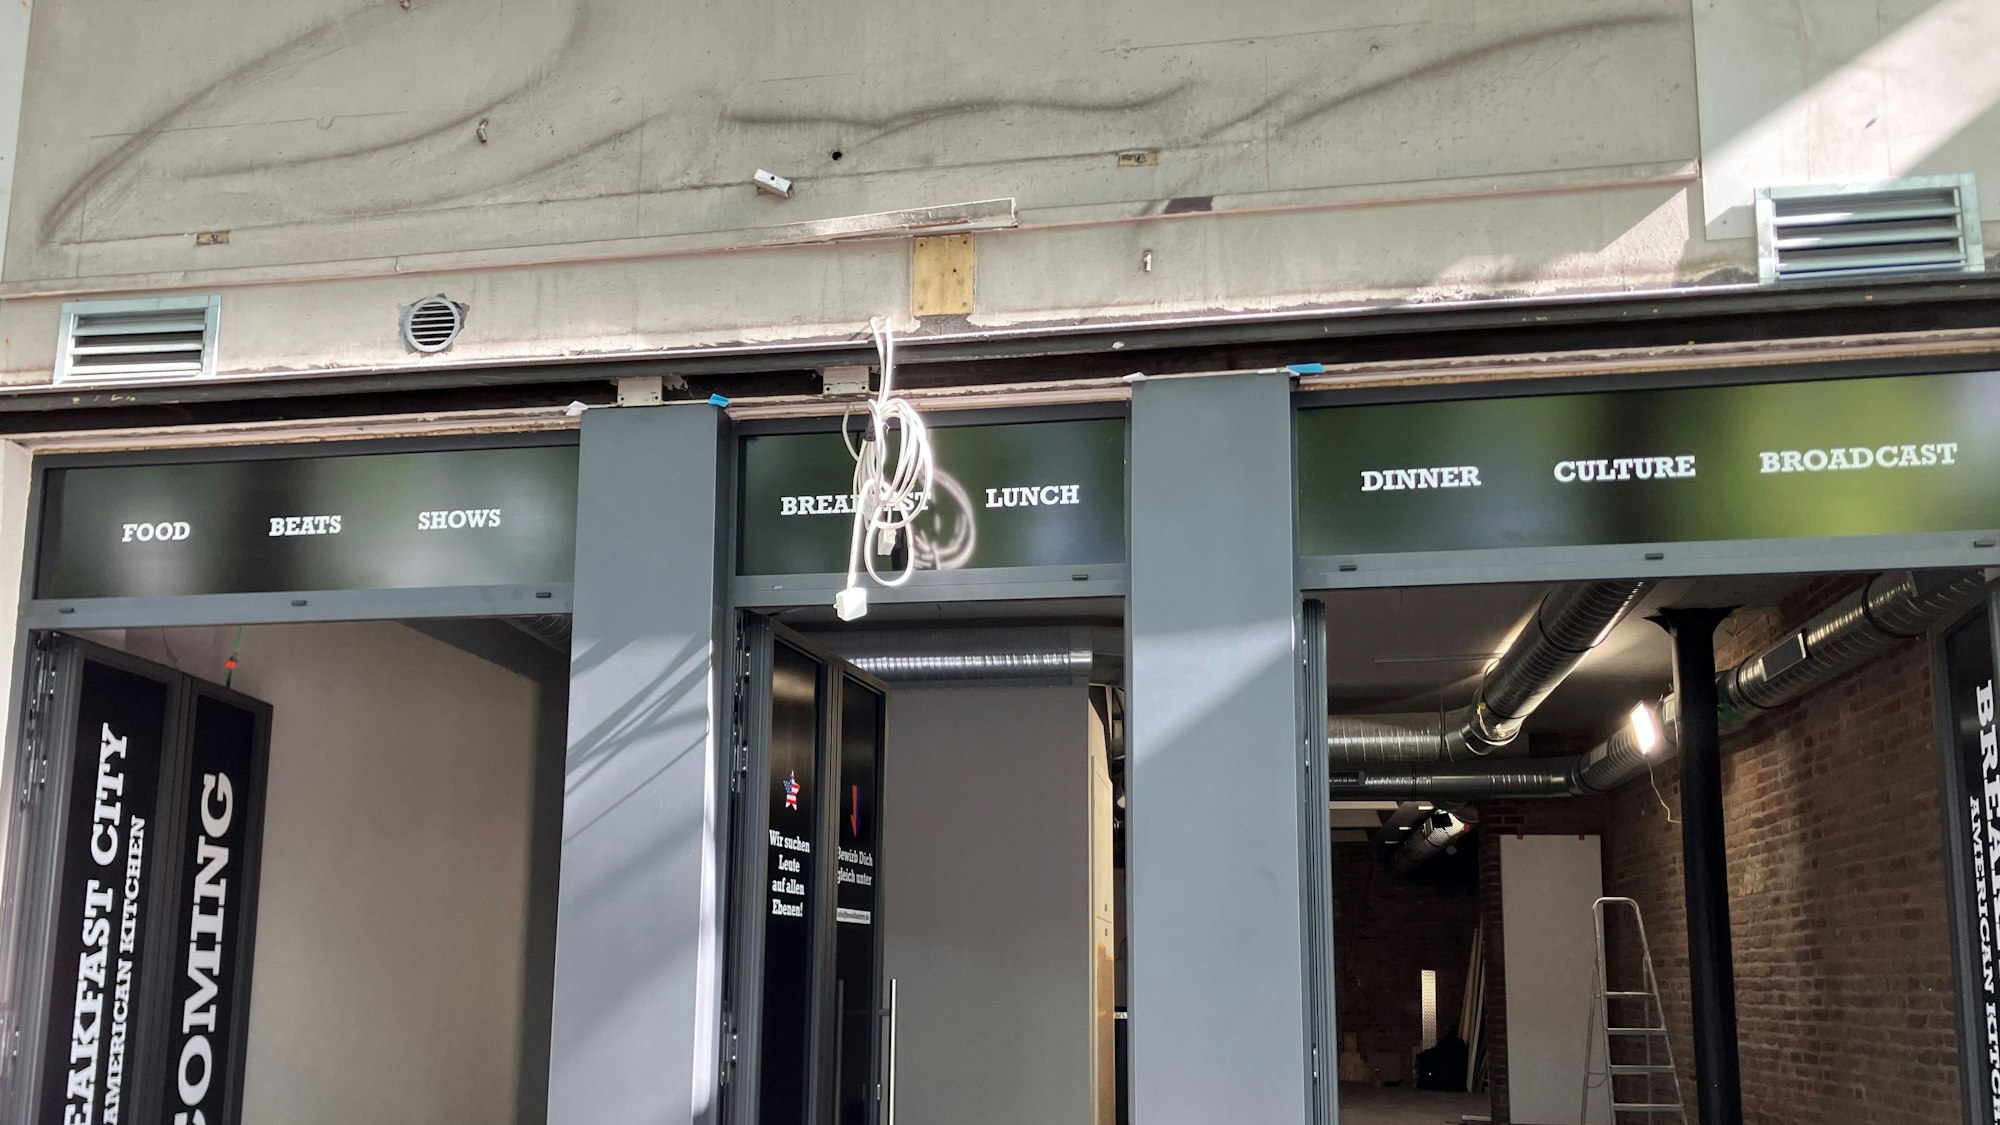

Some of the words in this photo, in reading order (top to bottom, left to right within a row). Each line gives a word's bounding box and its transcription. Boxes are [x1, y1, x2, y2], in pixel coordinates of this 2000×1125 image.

[1361, 465, 1482, 492] DINNER
[1553, 455, 1697, 483] CULTURE
[1760, 443, 1958, 474] BROADCAST
[780, 491, 932, 516] BREAST
[985, 484, 1080, 508] LUNCH
[121, 521, 191, 543] FOOD
[268, 515, 342, 537] BEATS
[418, 508, 501, 531] SHOWS
[90, 722, 128, 867] CITY
[769, 829, 784, 848] Wir
[784, 836, 811, 853] suchen
[778, 854, 801, 873] Leute
[859, 850, 873, 867] Dich
[119, 815, 146, 954] KITCHEN
[772, 877, 786, 893] auf
[786, 878, 805, 896] allen
[772, 899, 804, 917] Ebenen!
[174, 772, 234, 1125] OMING
[1970, 795, 1995, 994] AMERICAN
[1985, 1002, 2000, 1125] KITCH
